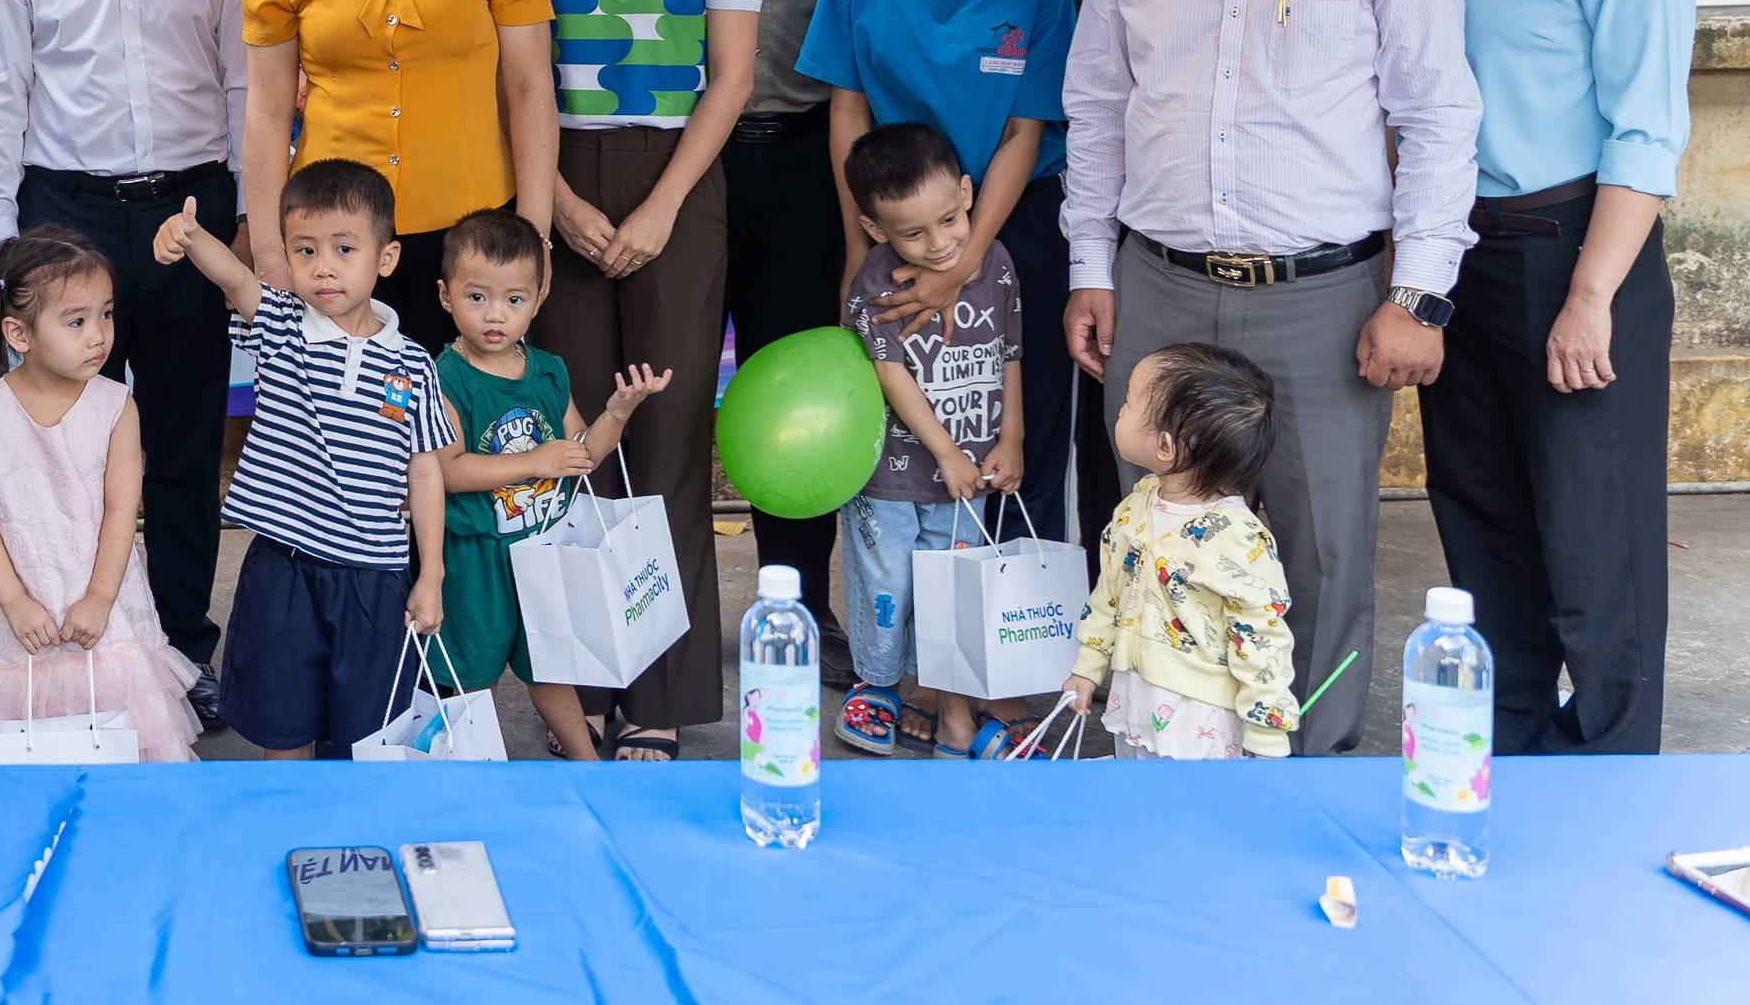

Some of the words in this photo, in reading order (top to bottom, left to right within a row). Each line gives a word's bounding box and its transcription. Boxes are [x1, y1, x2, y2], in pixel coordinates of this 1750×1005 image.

[943, 361, 985, 382] LIMIT
[497, 417, 534, 446] PUG
[624, 579, 637, 602] NHÀ
[634, 558, 659, 588] THUỐC
[625, 573, 670, 626] Pharmacity
[1002, 606, 1026, 623] NHÀ
[1027, 601, 1064, 620] THUỐC
[998, 618, 1073, 644] Pharmacity
